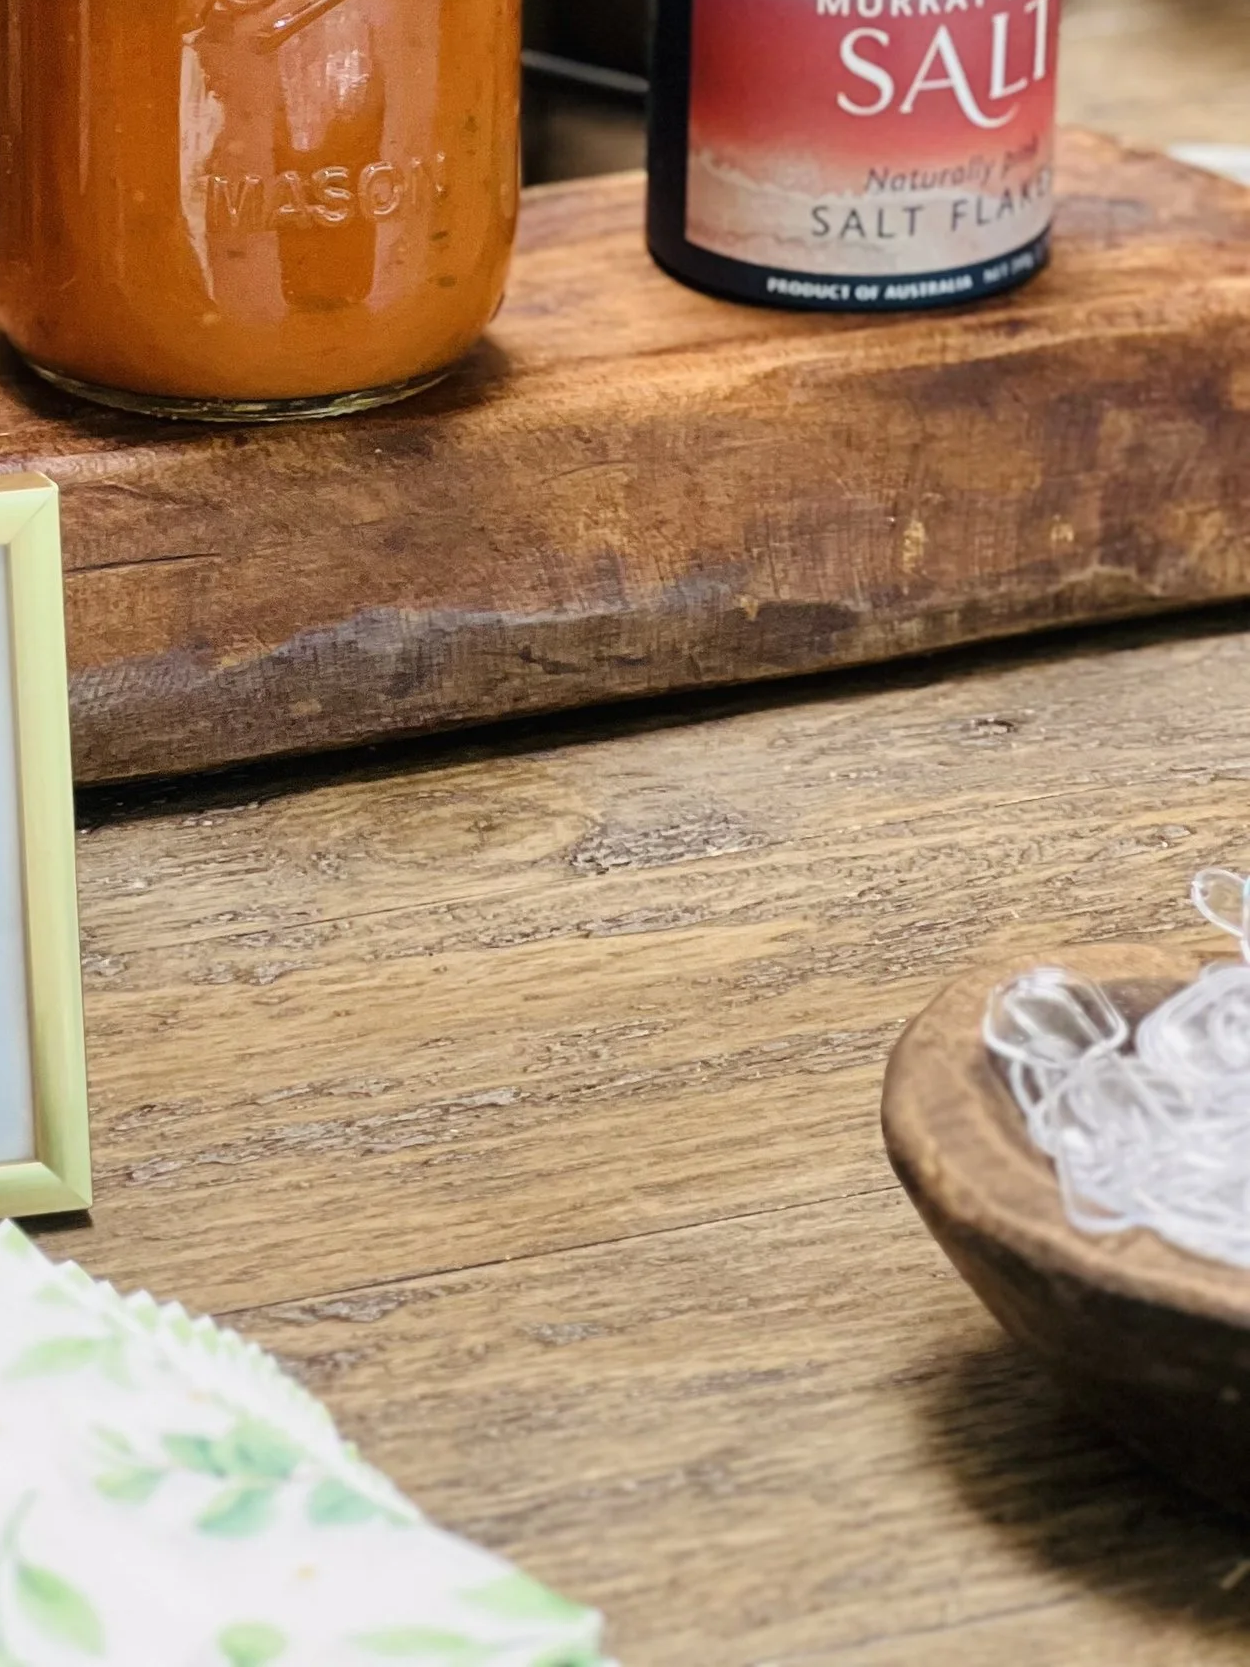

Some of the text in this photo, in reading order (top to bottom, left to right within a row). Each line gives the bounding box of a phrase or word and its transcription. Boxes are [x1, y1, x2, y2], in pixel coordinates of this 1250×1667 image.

[204, 148, 450, 228] MASON
[864, 153, 996, 193] Naturally
[811, 205, 924, 240] SALT
